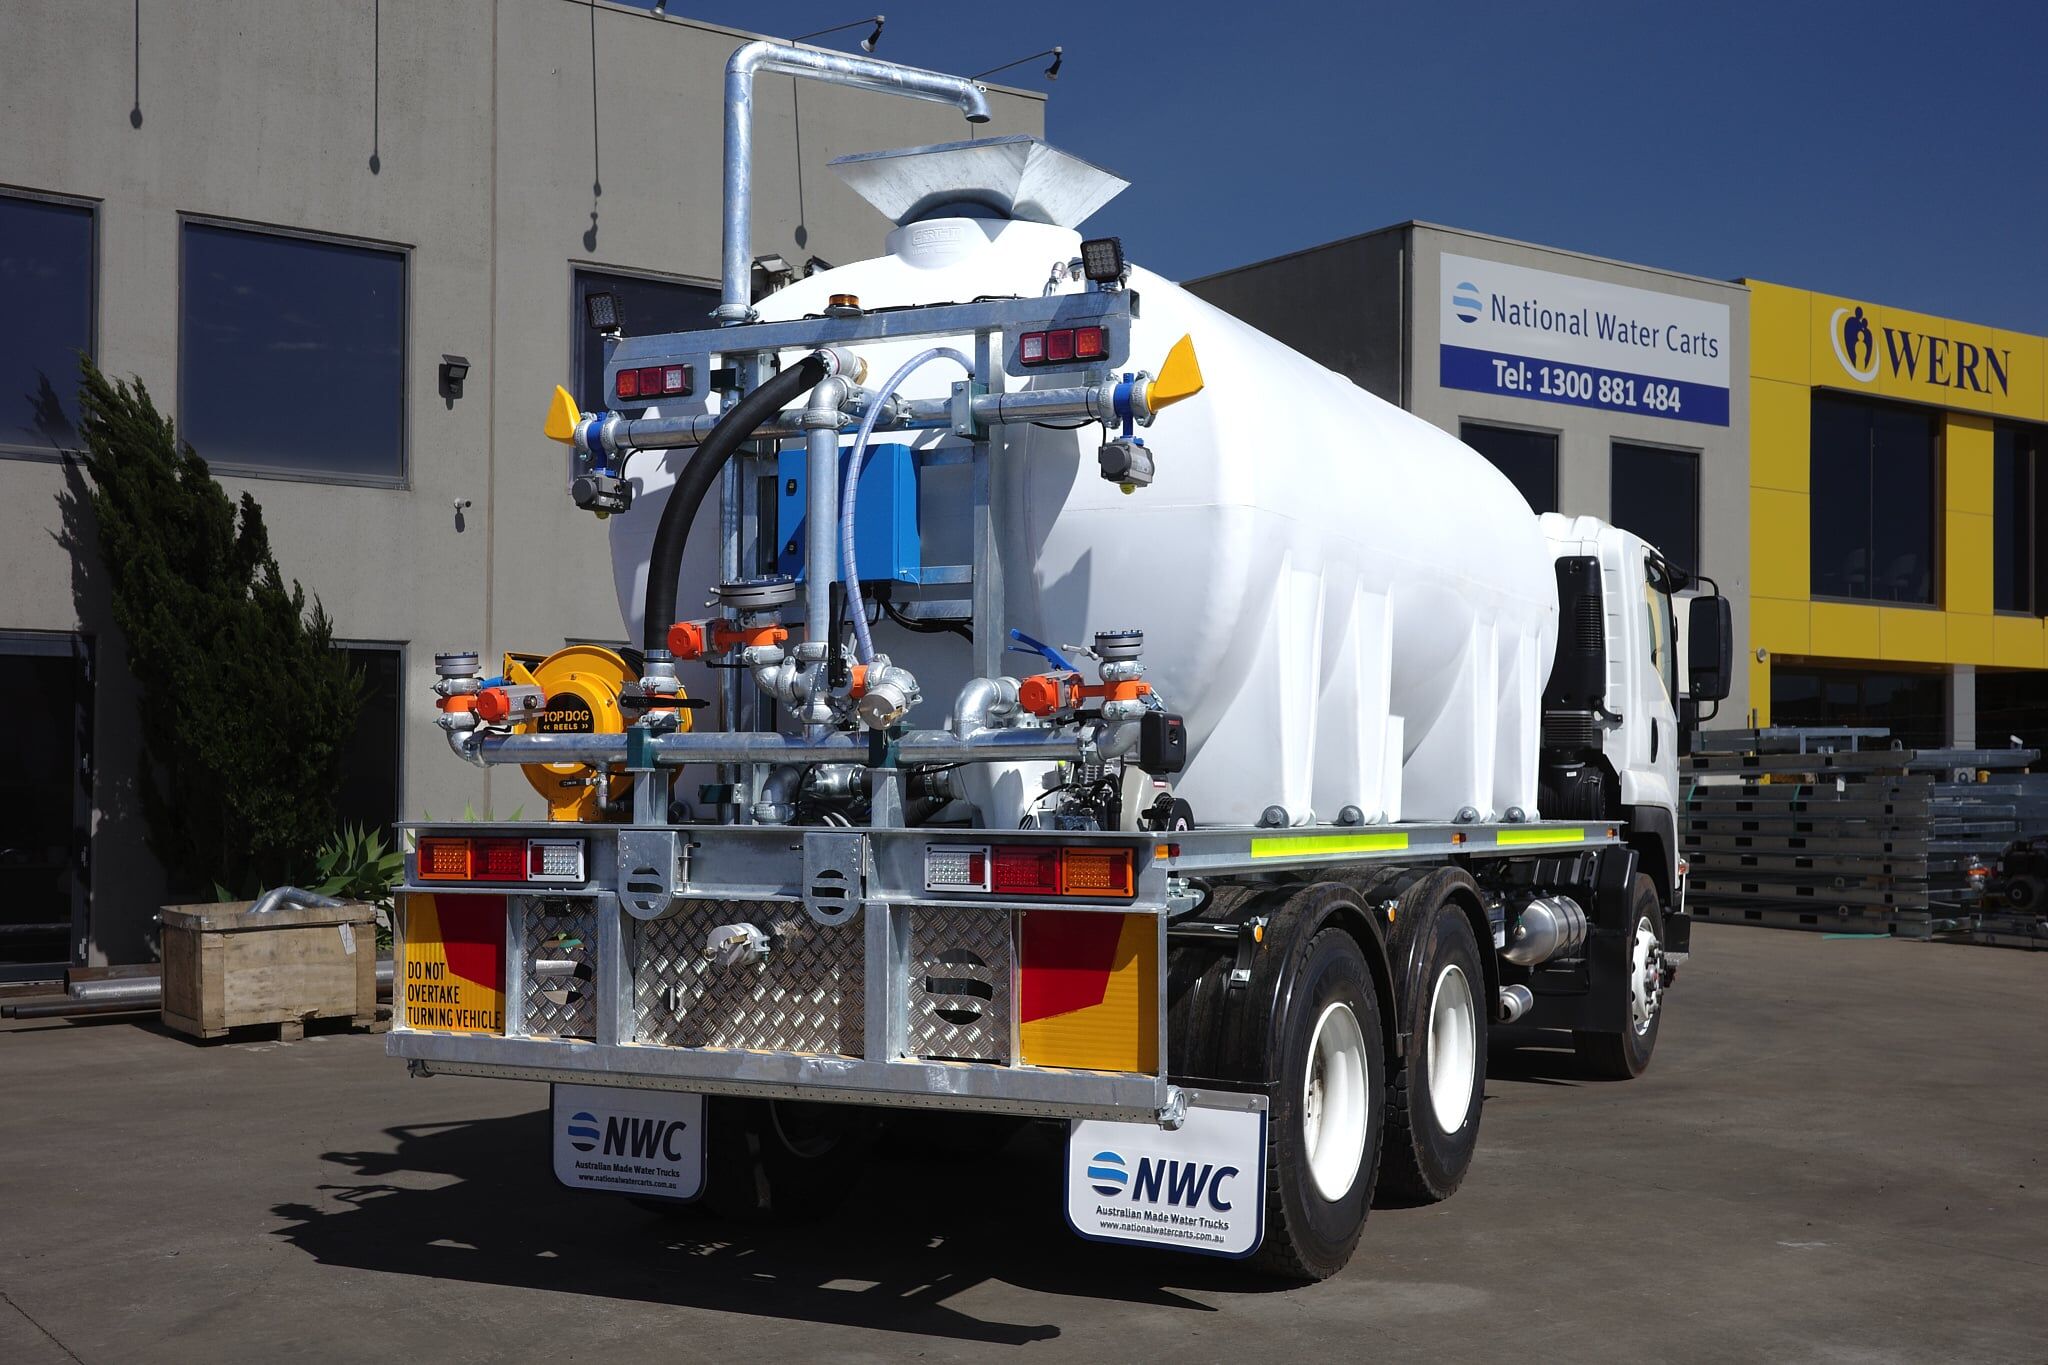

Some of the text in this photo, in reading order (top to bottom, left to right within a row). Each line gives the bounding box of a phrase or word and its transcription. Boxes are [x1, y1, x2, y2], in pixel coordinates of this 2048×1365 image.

[1491, 293, 1719, 358] National Water Carts
[1882, 327, 2012, 398] WERN
[1492, 359, 1681, 413] Tel: 1300 881 484
[544, 710, 589, 722] TOP DOG
[553, 723, 578, 731] REELS
[408, 961, 445, 981] DO NOT
[408, 984, 460, 1004] OVERTAKE
[408, 1007, 501, 1029] TURNING VEHICLE
[603, 1116, 687, 1162] NWC
[575, 1160, 680, 1178] Australian Made Water Trucks
[578, 1173, 677, 1189] www.nationalwatercarts.com.au
[1131, 1157, 1239, 1212] NWC
[1095, 1205, 1230, 1231] Australian Made Water Trucks
[1100, 1220, 1225, 1243] www.nationalwatercarts.com.au
